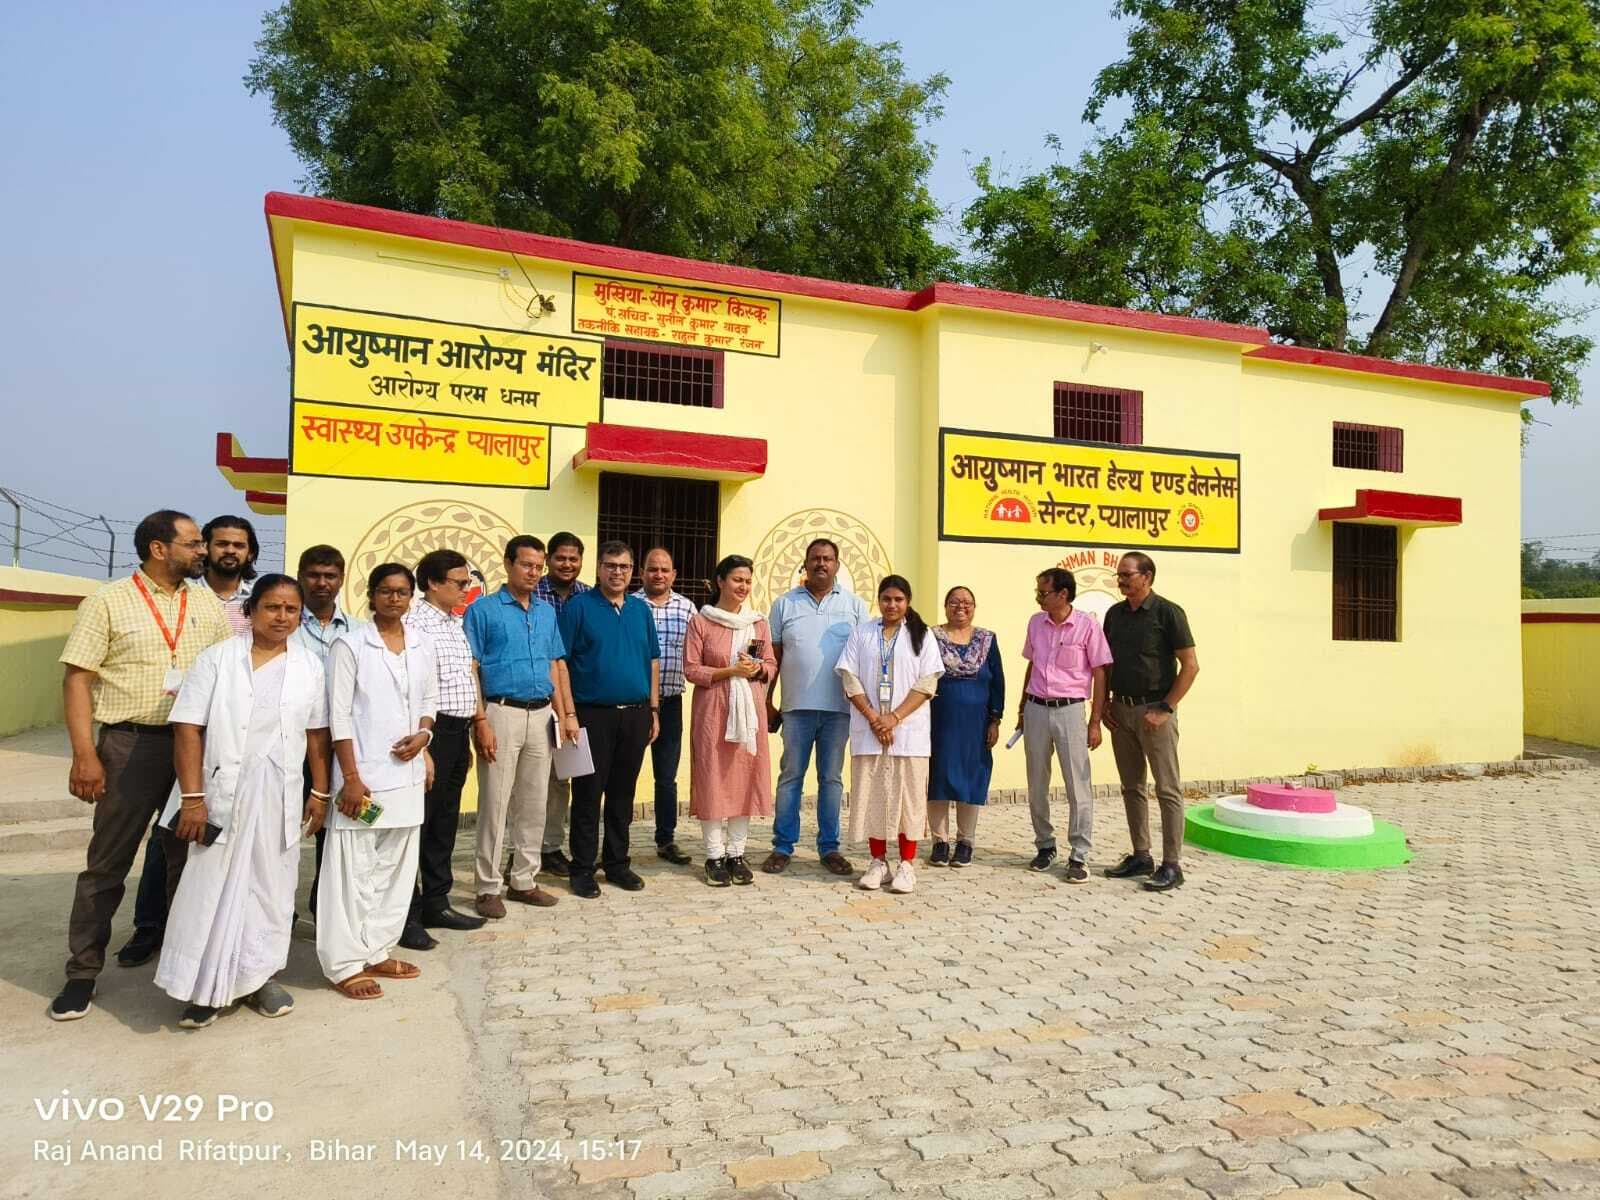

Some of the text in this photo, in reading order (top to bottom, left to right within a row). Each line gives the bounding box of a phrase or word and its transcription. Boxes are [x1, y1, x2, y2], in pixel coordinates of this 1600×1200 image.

[302, 323, 596, 381] आयुष्मान आरोग्य मंदिर
[368, 371, 540, 407] आरोग्य परम धनम
[302, 415, 544, 465] स्वास्थ्य उपकेन्द्र प्यालापुर
[951, 453, 1046, 491] आयुष्मान
[1053, 462, 1101, 489] भारत
[1107, 460, 1143, 493] हेल्थ
[1150, 471, 1185, 496] एण्ड
[1098, 504, 1170, 537] प्यालापुर
